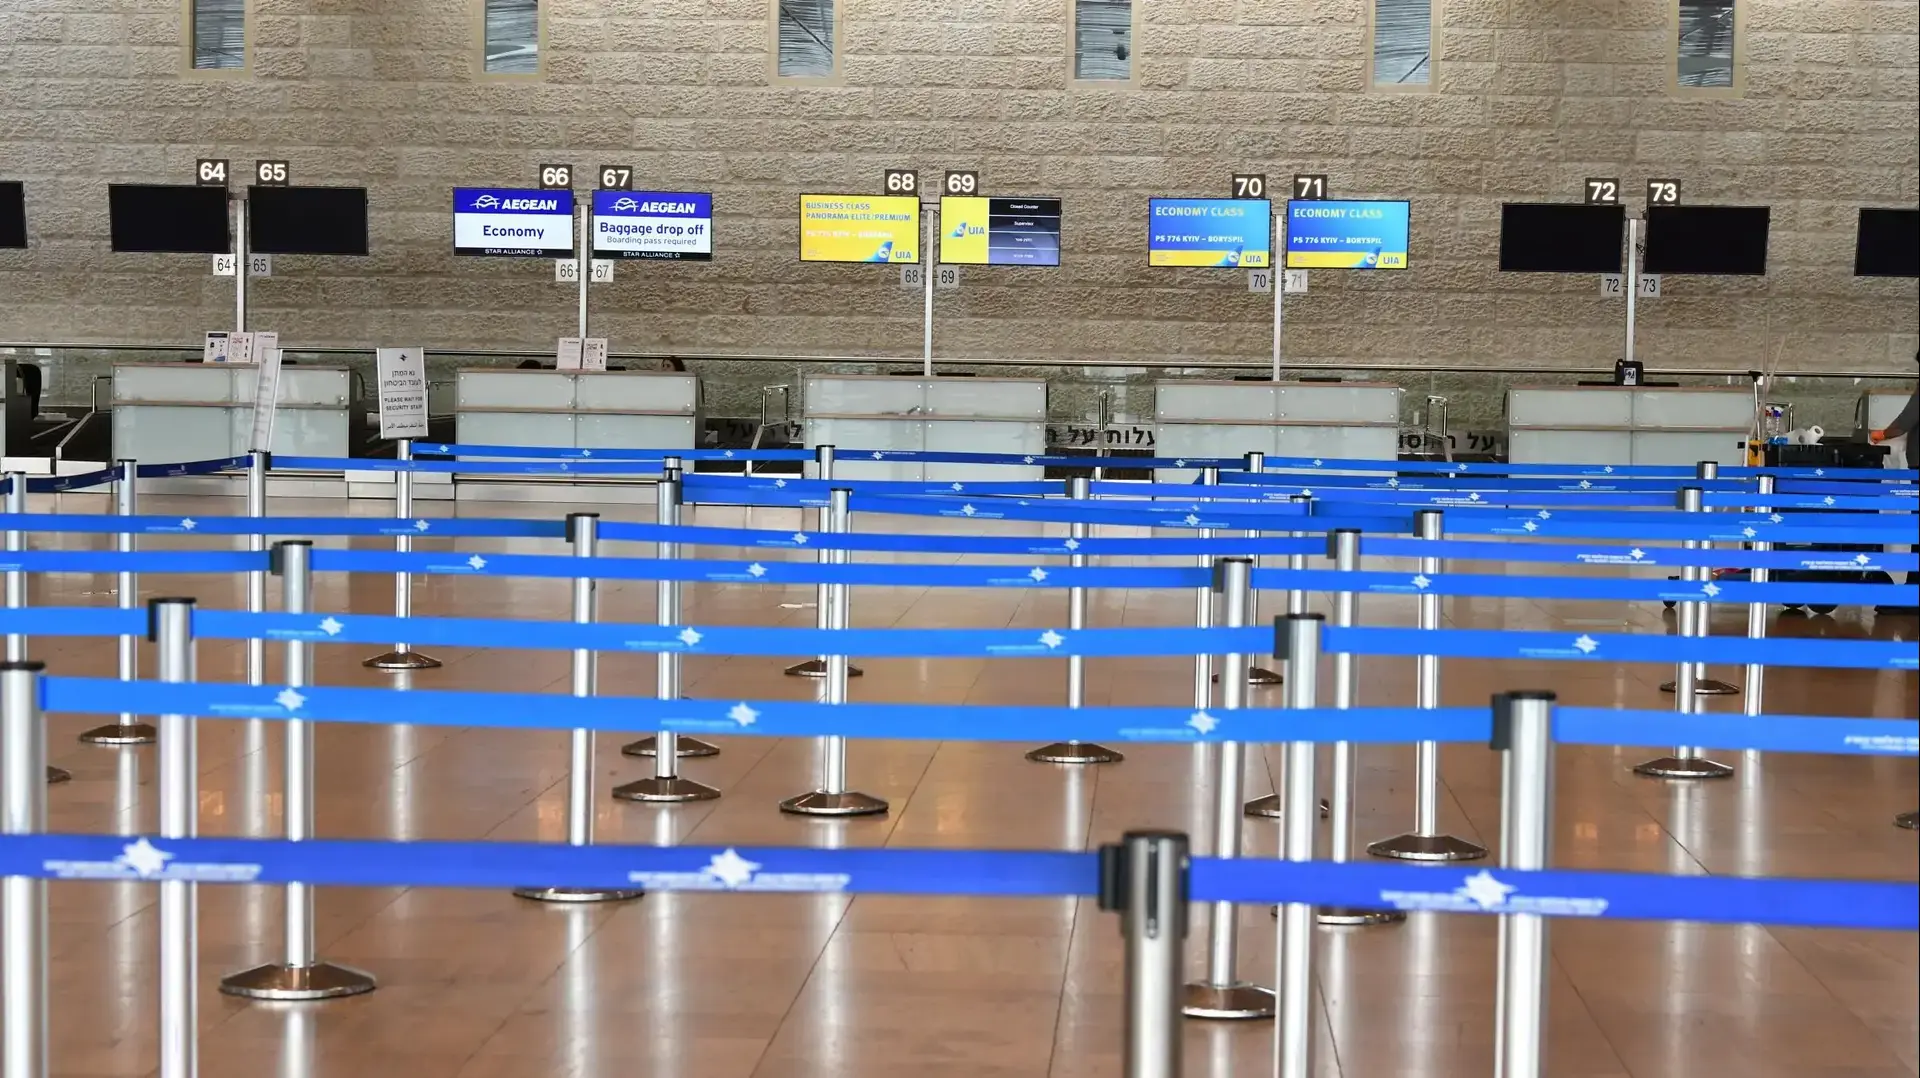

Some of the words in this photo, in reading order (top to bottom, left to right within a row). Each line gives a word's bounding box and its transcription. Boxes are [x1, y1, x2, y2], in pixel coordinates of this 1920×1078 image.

[200, 162, 225, 181] 64
[259, 163, 286, 181] 65
[542, 167, 569, 186] 66
[602, 169, 630, 187] 67
[888, 173, 914, 191] 68
[948, 174, 975, 193] 69
[1235, 178, 1262, 197] 70
[1297, 178, 1322, 197] 71
[1589, 182, 1616, 201] 72
[1650, 183, 1677, 202] 73
[501, 199, 557, 211] AEGEAN
[640, 202, 695, 214] AEGEAN
[1155, 207, 1208, 216] ECONOMY
[1211, 207, 1244, 217] CLASS
[806, 212, 849, 220] PANORAMA
[1294, 208, 1347, 218] ECONOMY
[1349, 209, 1383, 219] CLASS
[483, 225, 545, 239] Economy
[600, 222, 653, 236] Baggage
[656, 223, 684, 236] drop
[688, 224, 704, 235] off
[968, 226, 985, 235] UIA
[606, 235, 642, 245] Boarding
[643, 238, 662, 246] pass
[664, 237, 697, 246] required
[1208, 235, 1244, 243] BORYSPIL
[895, 251, 912, 259] UIA
[1245, 255, 1262, 263] UIA
[1383, 256, 1399, 264] UIA
[217, 257, 231, 271] 64
[253, 258, 267, 272] 65
[560, 263, 574, 277] 66
[596, 264, 609, 278] 67
[905, 269, 918, 283] 68
[941, 270, 955, 283] 69
[1253, 274, 1266, 288] 70
[1291, 274, 1302, 288] 71
[1606, 279, 1619, 292] 72
[1643, 279, 1656, 292] 73
[1068, 425, 1095, 445] על
[1467, 431, 1495, 451] על
